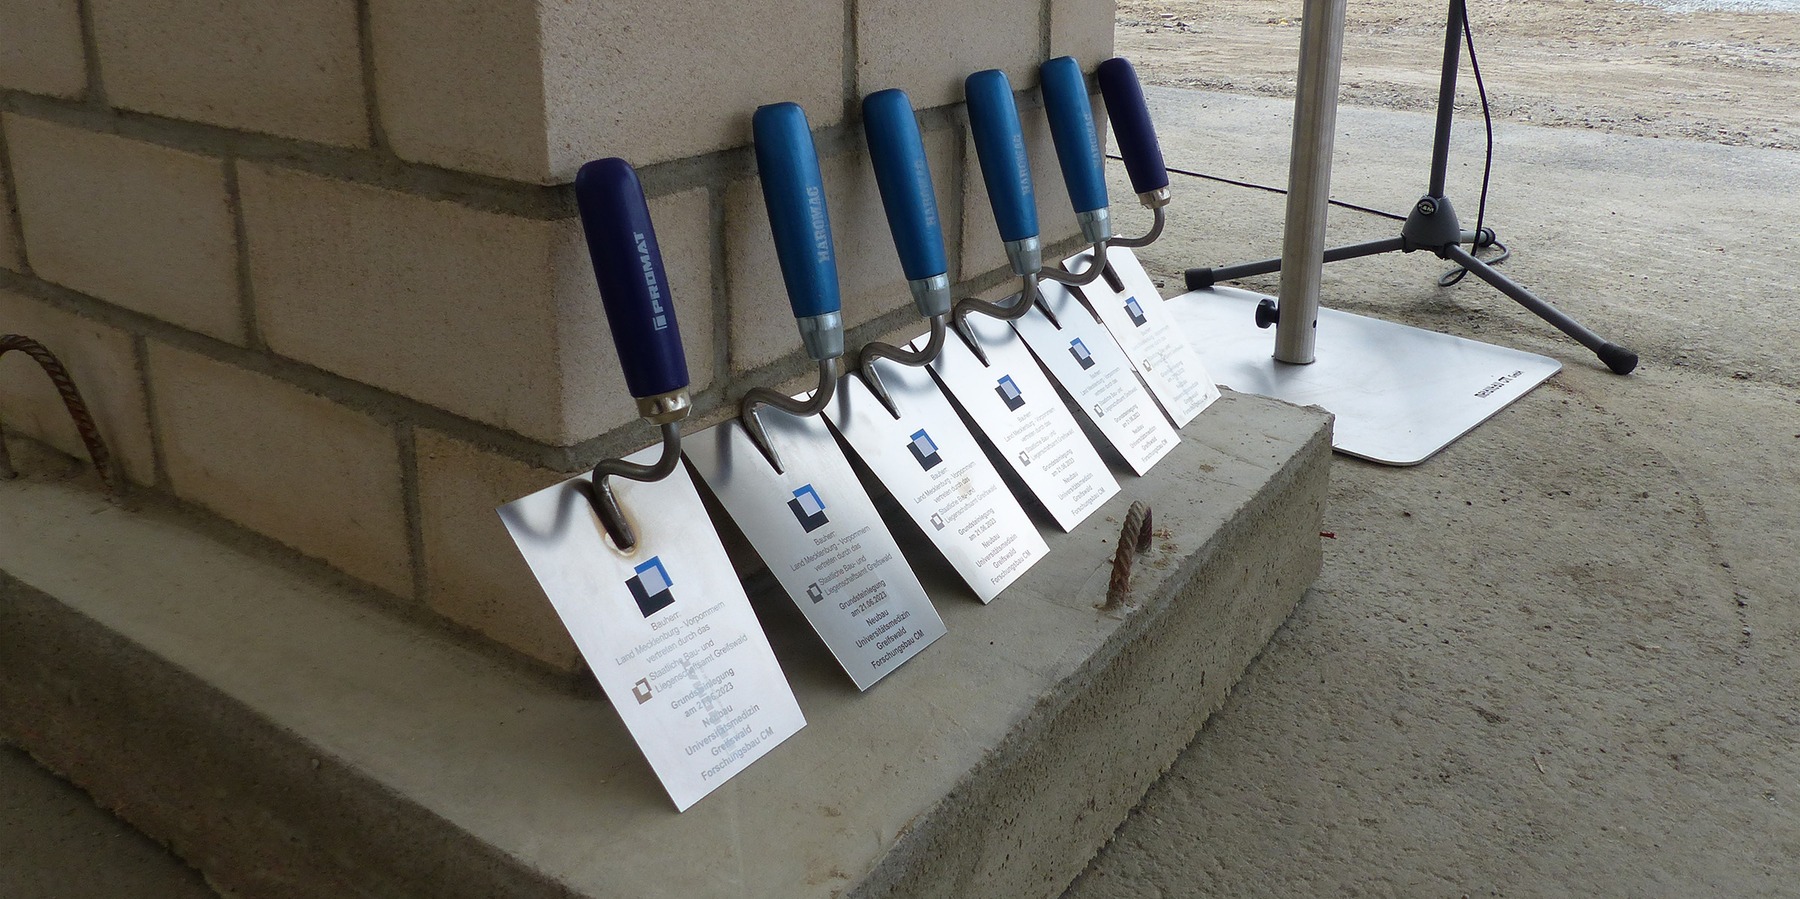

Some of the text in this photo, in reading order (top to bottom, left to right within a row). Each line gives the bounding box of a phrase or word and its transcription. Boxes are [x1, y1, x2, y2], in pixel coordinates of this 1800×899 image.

[807, 186, 830, 264] HAROMAC
[633, 231, 664, 312] PROMAT
[958, 508, 995, 535] Grundsteinlegung
[837, 548, 851, 559] durch
[851, 543, 861, 551] das
[982, 534, 1000, 548] Neubau
[790, 560, 805, 571] Land
[818, 555, 866, 585] Staatliche Bau- und
[867, 553, 892, 571] Greifswald
[990, 549, 1031, 585] Forschungsbau CM
[993, 547, 1016, 568] Greifswald
[839, 580, 886, 610] Grundsteinlegung
[851, 591, 887, 617] am 21.06.2023
[855, 611, 910, 648] Universitätsmedizin
[866, 610, 889, 626] Neubau
[615, 649, 635, 665] Land
[634, 627, 680, 654] Mecklenburg
[683, 602, 725, 628] Vorpommern
[646, 624, 710, 662] vertreten durch das
[714, 634, 748, 658] Greifswald
[876, 626, 906, 650] Greifswald
[649, 639, 714, 680] Staatliche Bau- und
[871, 630, 924, 669] Forschungsbau CM
[684, 706, 697, 717] am
[701, 726, 774, 781] Forschungsbau CM
